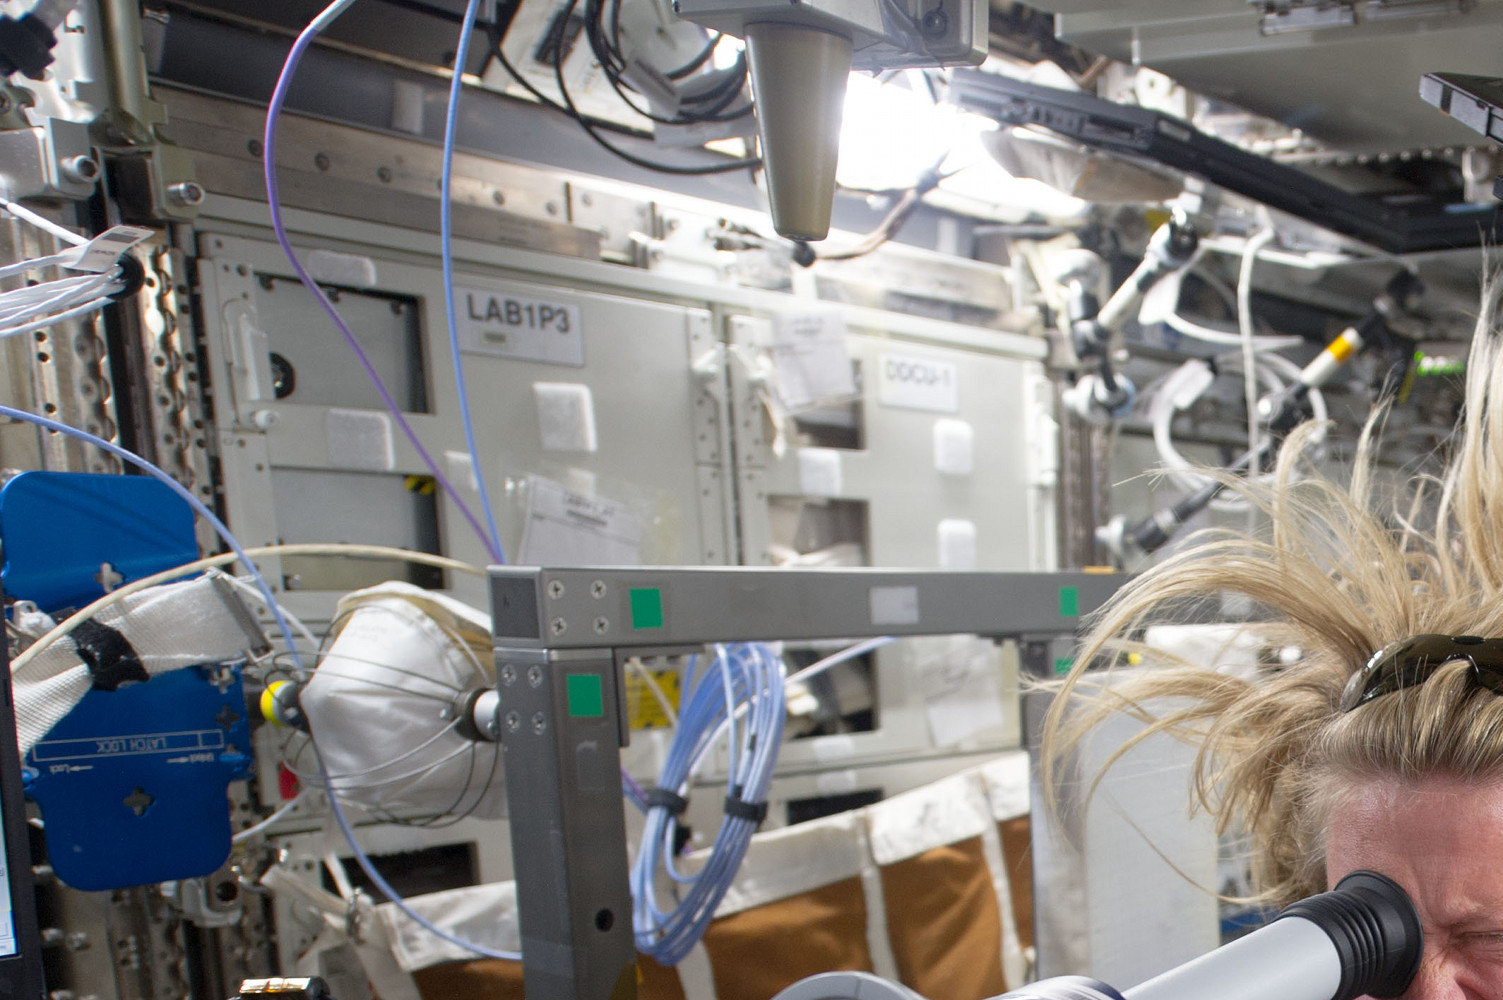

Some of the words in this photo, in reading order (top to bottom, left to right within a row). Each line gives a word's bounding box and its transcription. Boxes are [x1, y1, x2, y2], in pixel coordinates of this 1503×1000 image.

[466, 293, 570, 334] LAB1P3
[97, 738, 126, 753] LOCK
[130, 736, 167, 752] LATCH
